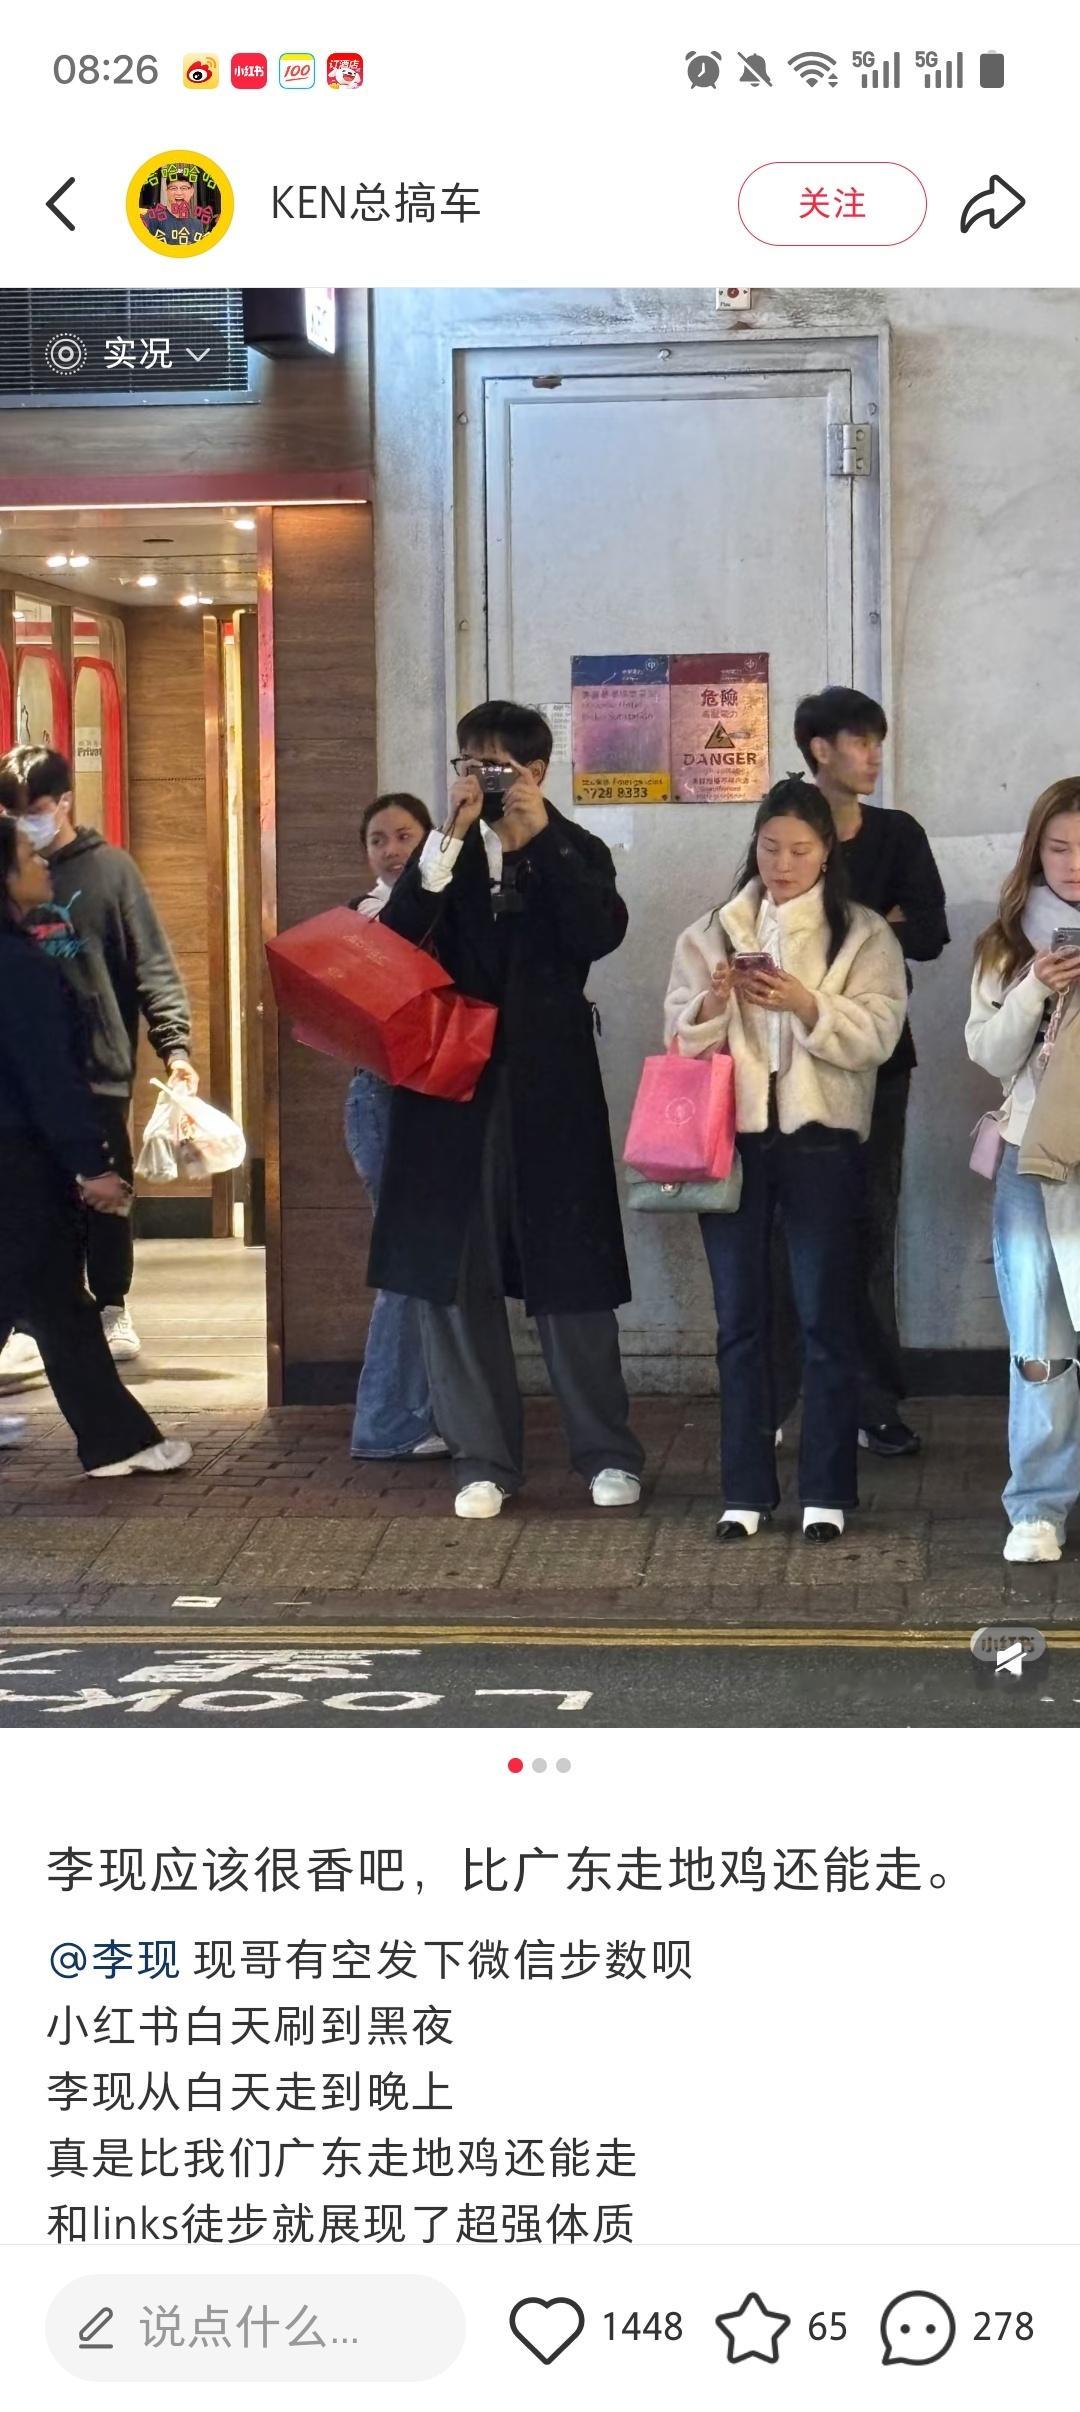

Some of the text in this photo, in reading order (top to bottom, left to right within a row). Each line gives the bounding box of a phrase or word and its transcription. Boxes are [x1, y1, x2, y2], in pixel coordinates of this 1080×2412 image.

[701, 688, 738, 707] 危險
[683, 752, 757, 766] DANGER
[617, 787, 648, 798] 8333
